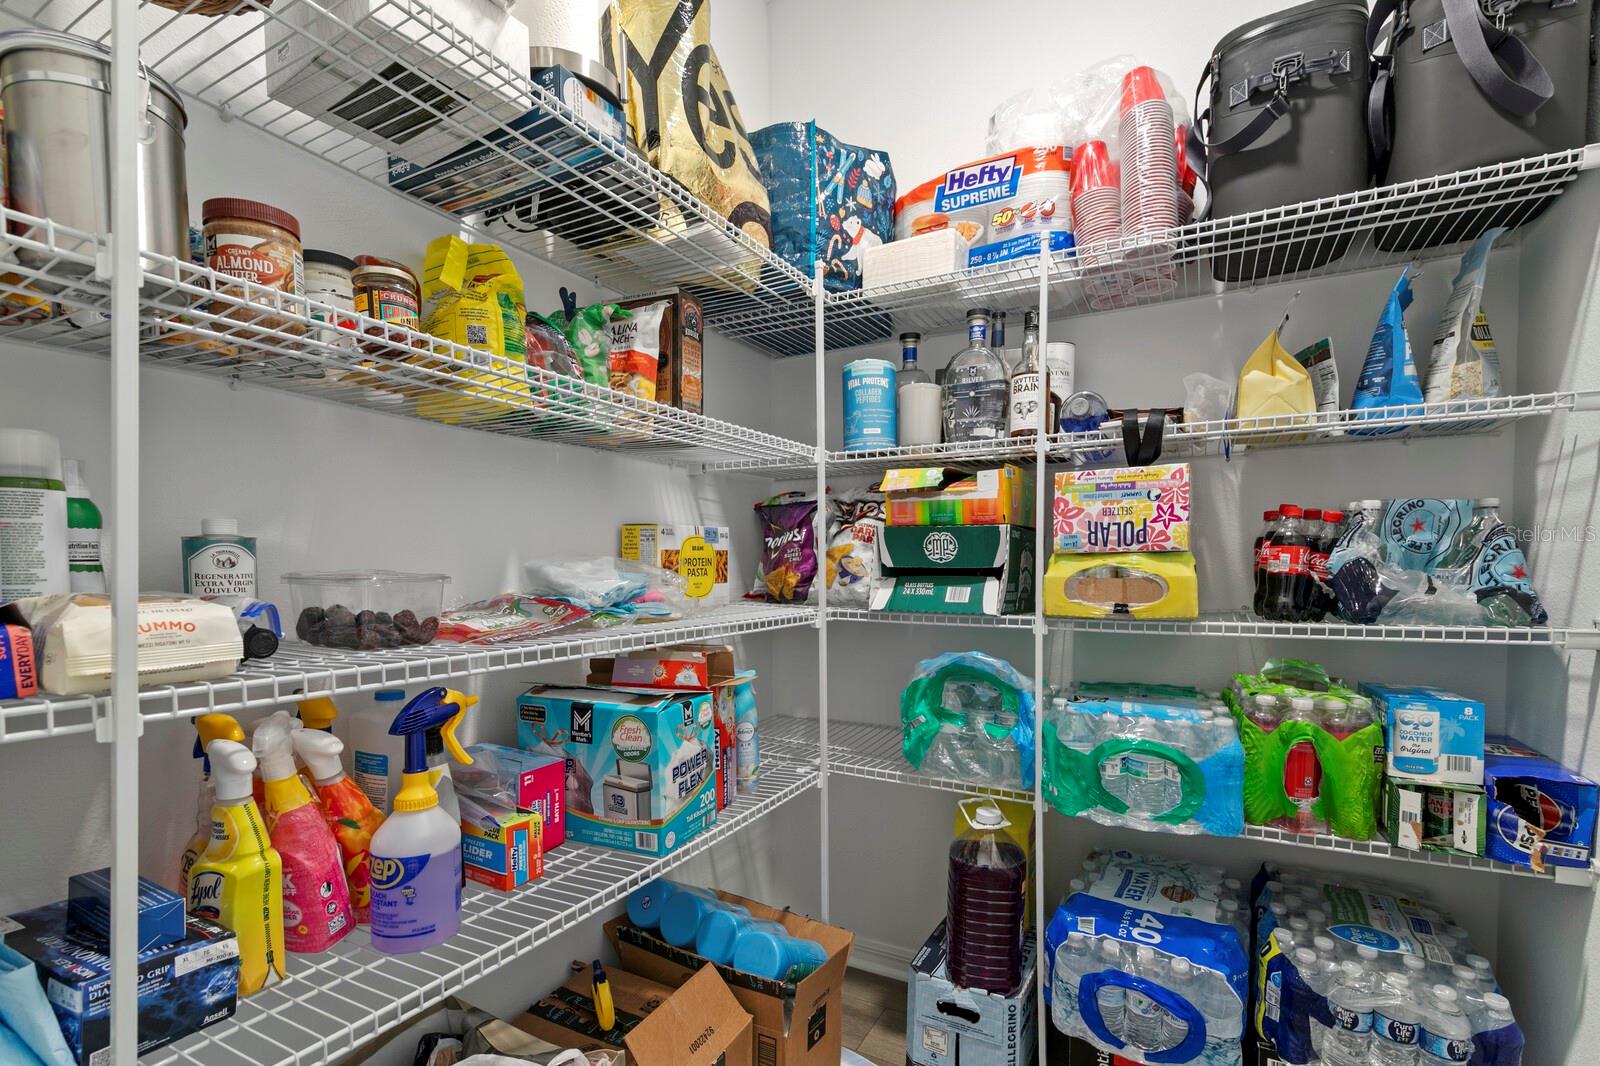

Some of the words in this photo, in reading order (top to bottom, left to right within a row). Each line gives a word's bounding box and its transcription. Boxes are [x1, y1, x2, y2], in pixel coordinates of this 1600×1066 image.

[949, 164, 1013, 191] Hefty
[941, 184, 1011, 210] SUPREME
[216, 255, 274, 274] ALMOND
[862, 376, 889, 389] PROTEINS
[1102, 506, 1134, 516] SELTZER
[1087, 518, 1148, 548] POLAR
[684, 557, 713, 567] PROTEIN
[687, 567, 709, 577] PASTA
[138, 621, 196, 634] UMMO
[16, 635, 33, 689] EVERYDAY
[1464, 707, 1473, 715] 8
[571, 730, 592, 738] Member's
[620, 724, 642, 734] Fresh
[1399, 729, 1433, 737] COCONUT
[620, 732, 643, 743] Clean
[1399, 734, 1433, 743] WATER
[1400, 745, 1432, 755] Original
[672, 748, 708, 784] POWER
[678, 772, 705, 799] FLEX
[699, 787, 716, 808] 200
[484, 831, 500, 840] PACK
[1123, 871, 1150, 902] WATER
[1118, 928, 1127, 938] OZ
[1131, 912, 1165, 944] 40
[146, 964, 170, 979] GRIP
[203, 1007, 228, 1024] Ansell
[1336, 1006, 1355, 1018] Pure
[1338, 1012, 1353, 1024] Life
[1393, 1021, 1414, 1032] Pure
[1395, 1027, 1411, 1038] Life
